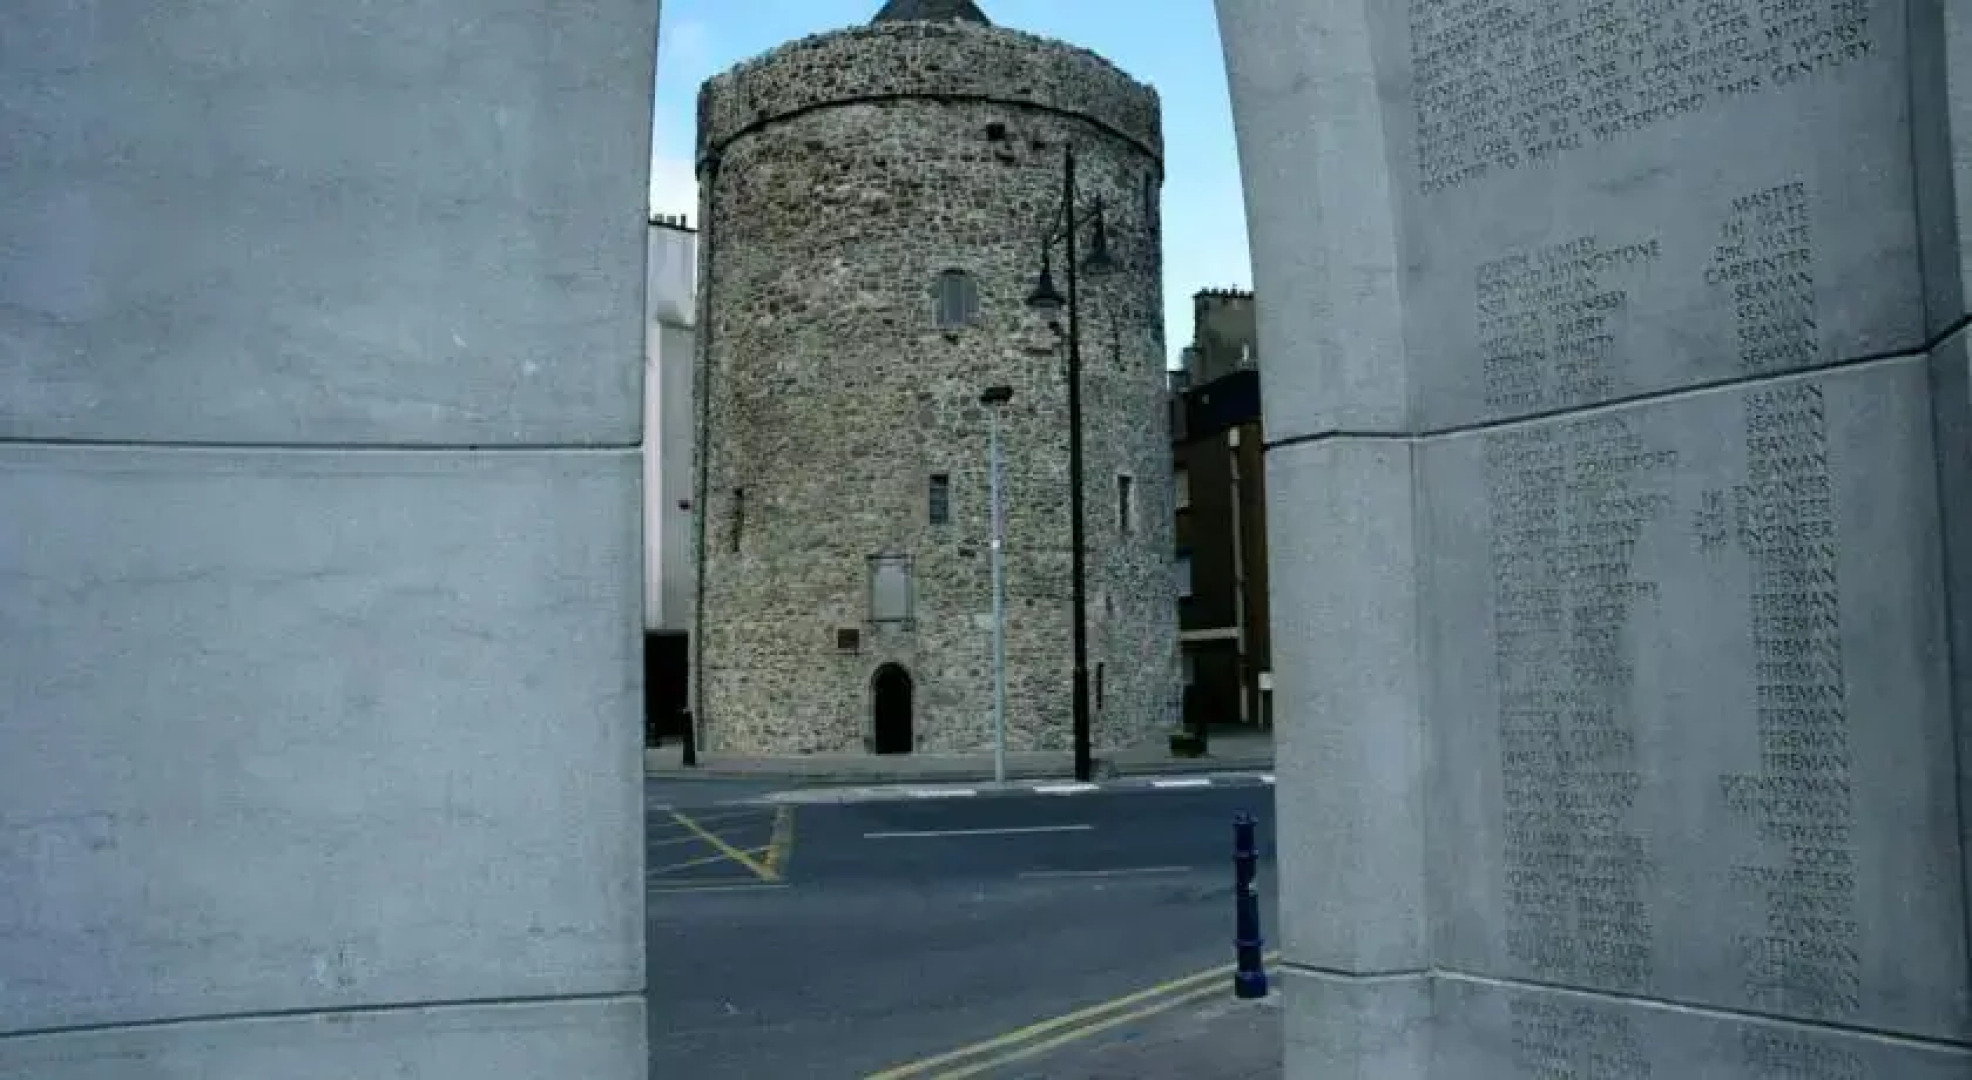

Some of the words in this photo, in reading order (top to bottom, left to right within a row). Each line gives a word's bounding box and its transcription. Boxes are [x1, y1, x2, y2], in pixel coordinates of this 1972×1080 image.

[1730, 180, 1804, 213] MASTER
[1703, 248, 1811, 286] CARPENTER
[1732, 270, 1813, 301] SEAMAN
[1735, 291, 1814, 322] SEAMAN
[1736, 314, 1817, 345] SEAMAN
[1737, 337, 1819, 367] SEAMAN
[1743, 381, 1823, 410] SEAMAN
[1745, 406, 1824, 432] SEAMAN
[1745, 428, 1826, 455] SEAMAN
[1747, 450, 1827, 477] SEAMAN
[1732, 473, 1830, 503] ENGINEER
[1734, 495, 1831, 523] ENGINEER
[1735, 518, 1833, 546] ENGINEER
[1748, 589, 1838, 612] FIREMAN
[1751, 611, 1839, 635] FIREMAN
[1753, 635, 1841, 656] FIREMAN
[1754, 660, 1842, 681] FIREMAN
[1756, 682, 1844, 703] FIREMAN
[1756, 706, 1845, 726] FIREMAN
[1757, 729, 1846, 748] FIREMAN
[1759, 753, 1848, 771] FIREMAN
